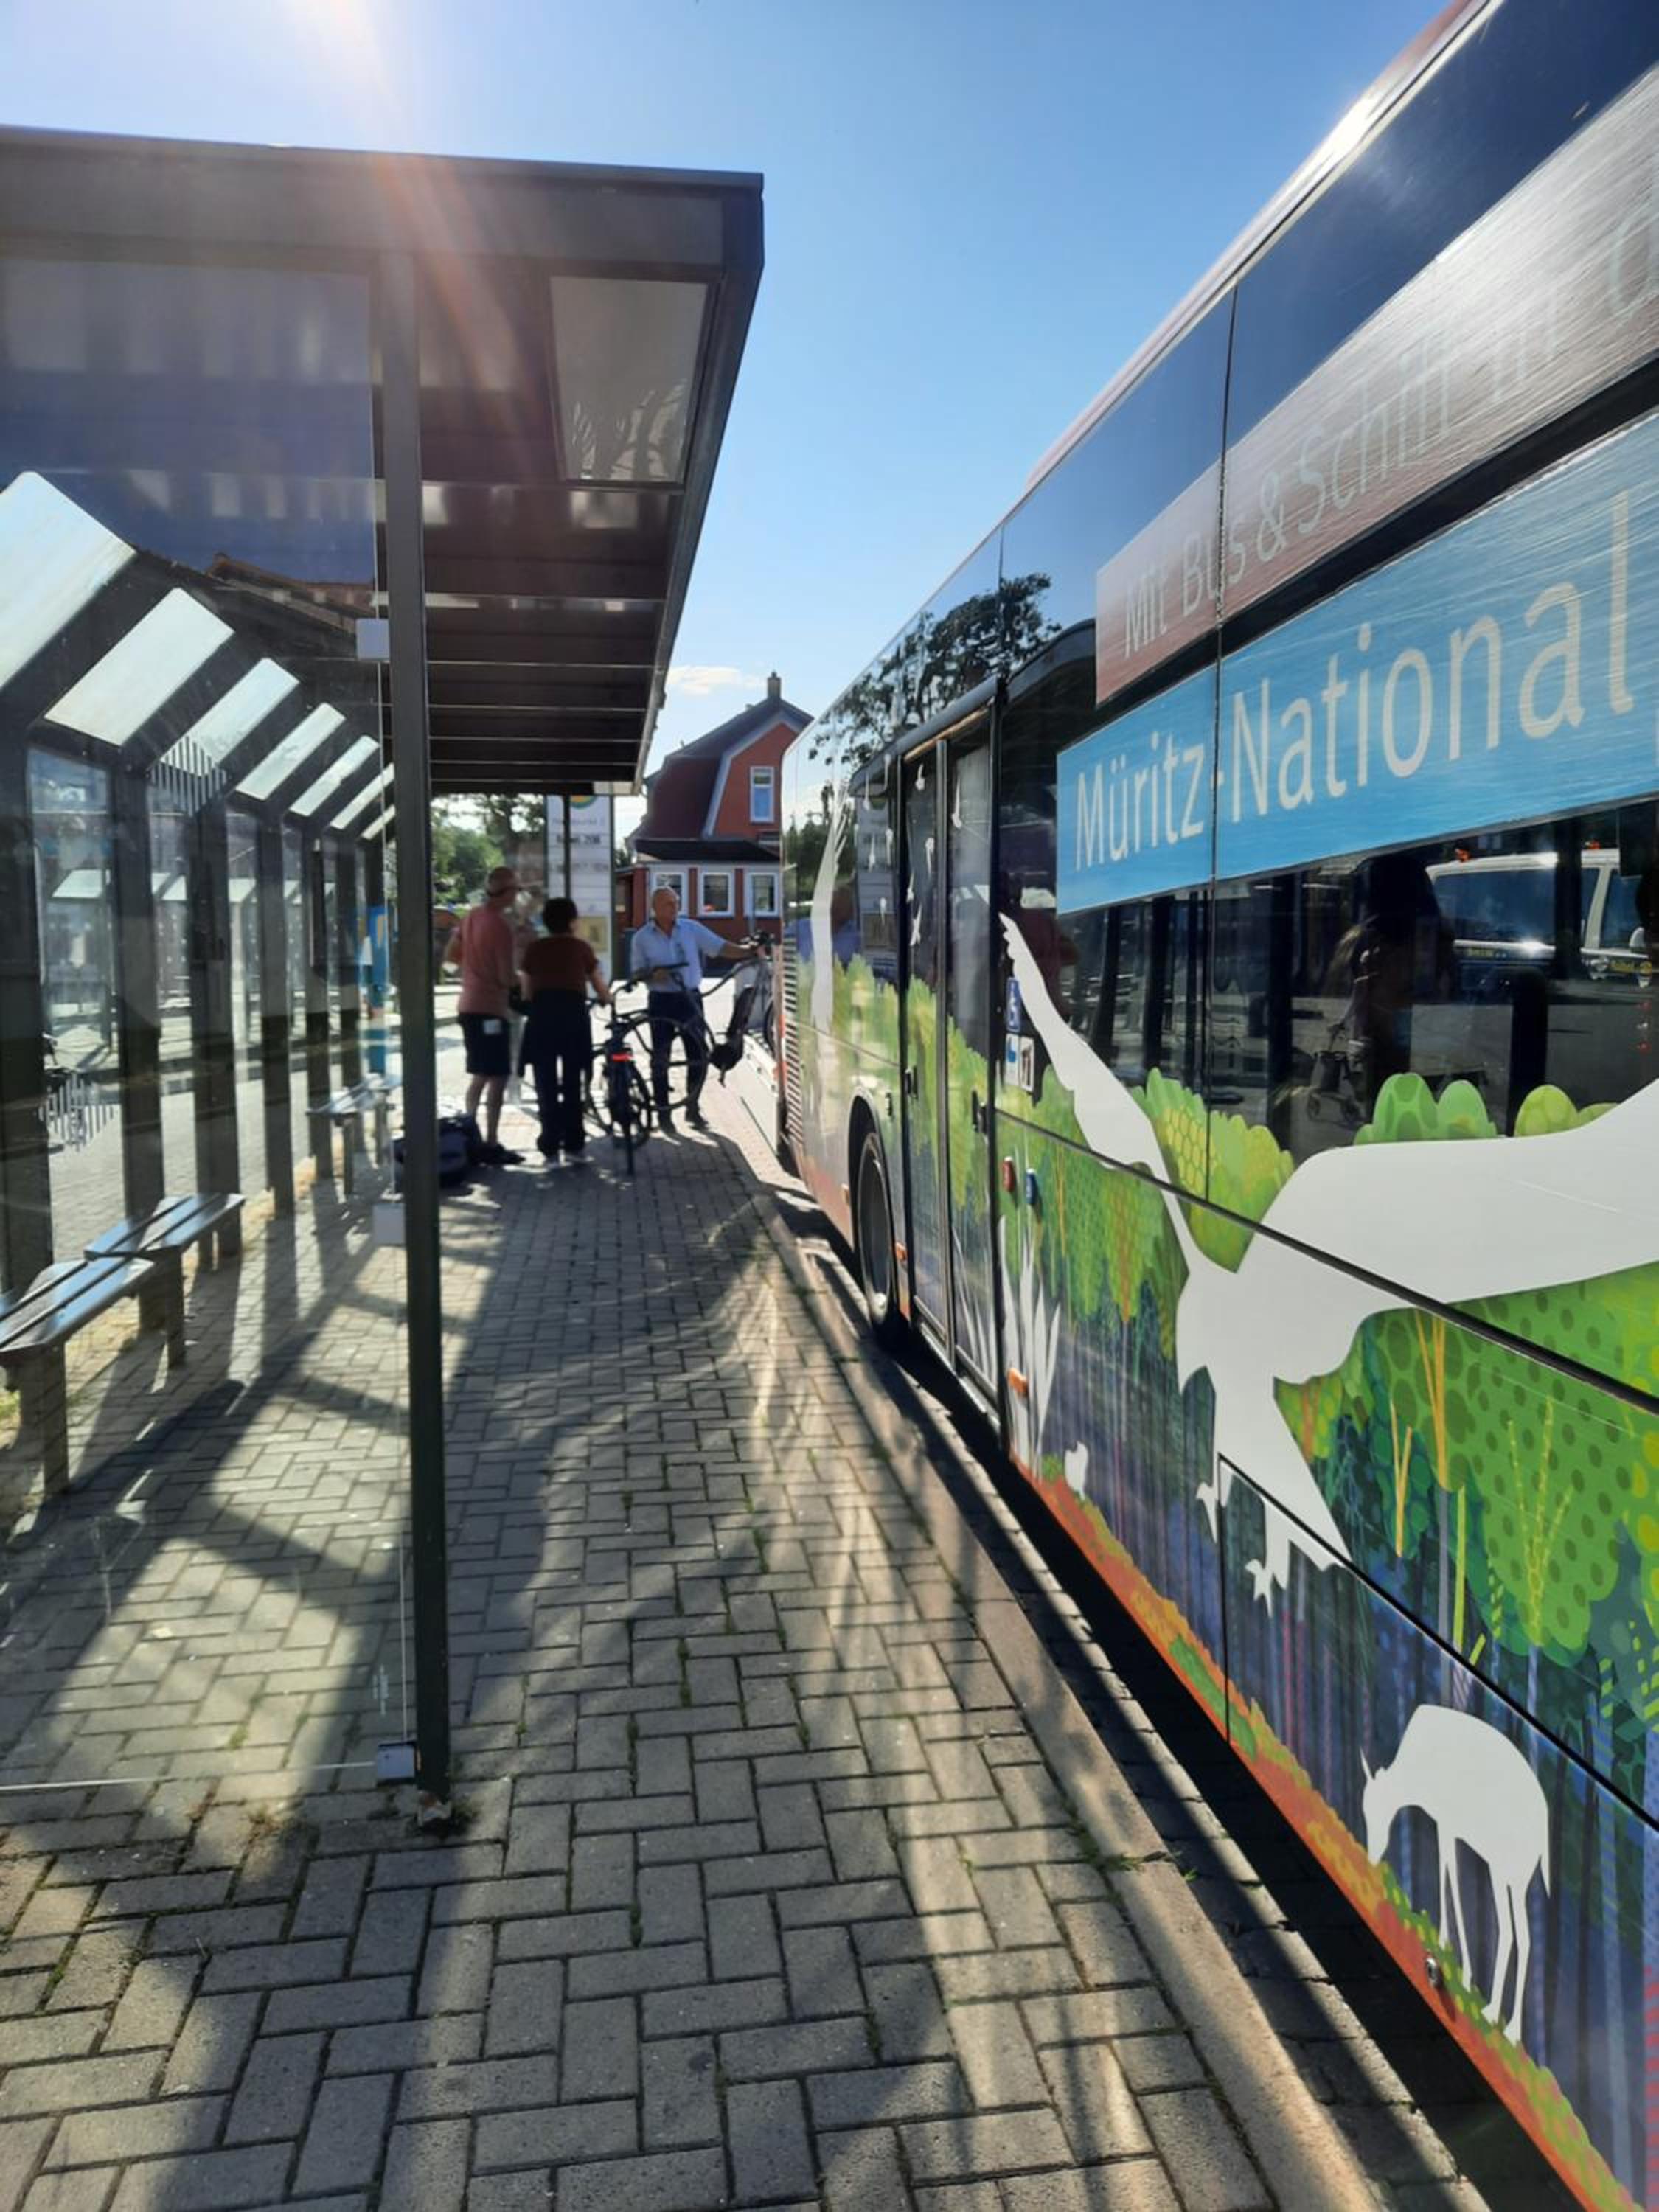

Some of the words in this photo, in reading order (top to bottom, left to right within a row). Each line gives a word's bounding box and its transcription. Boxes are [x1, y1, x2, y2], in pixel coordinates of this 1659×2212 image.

[1183, 512, 1246, 616] Bus
[1256, 470, 1287, 563] &
[1075, 490, 1659, 872] Müritz-National
